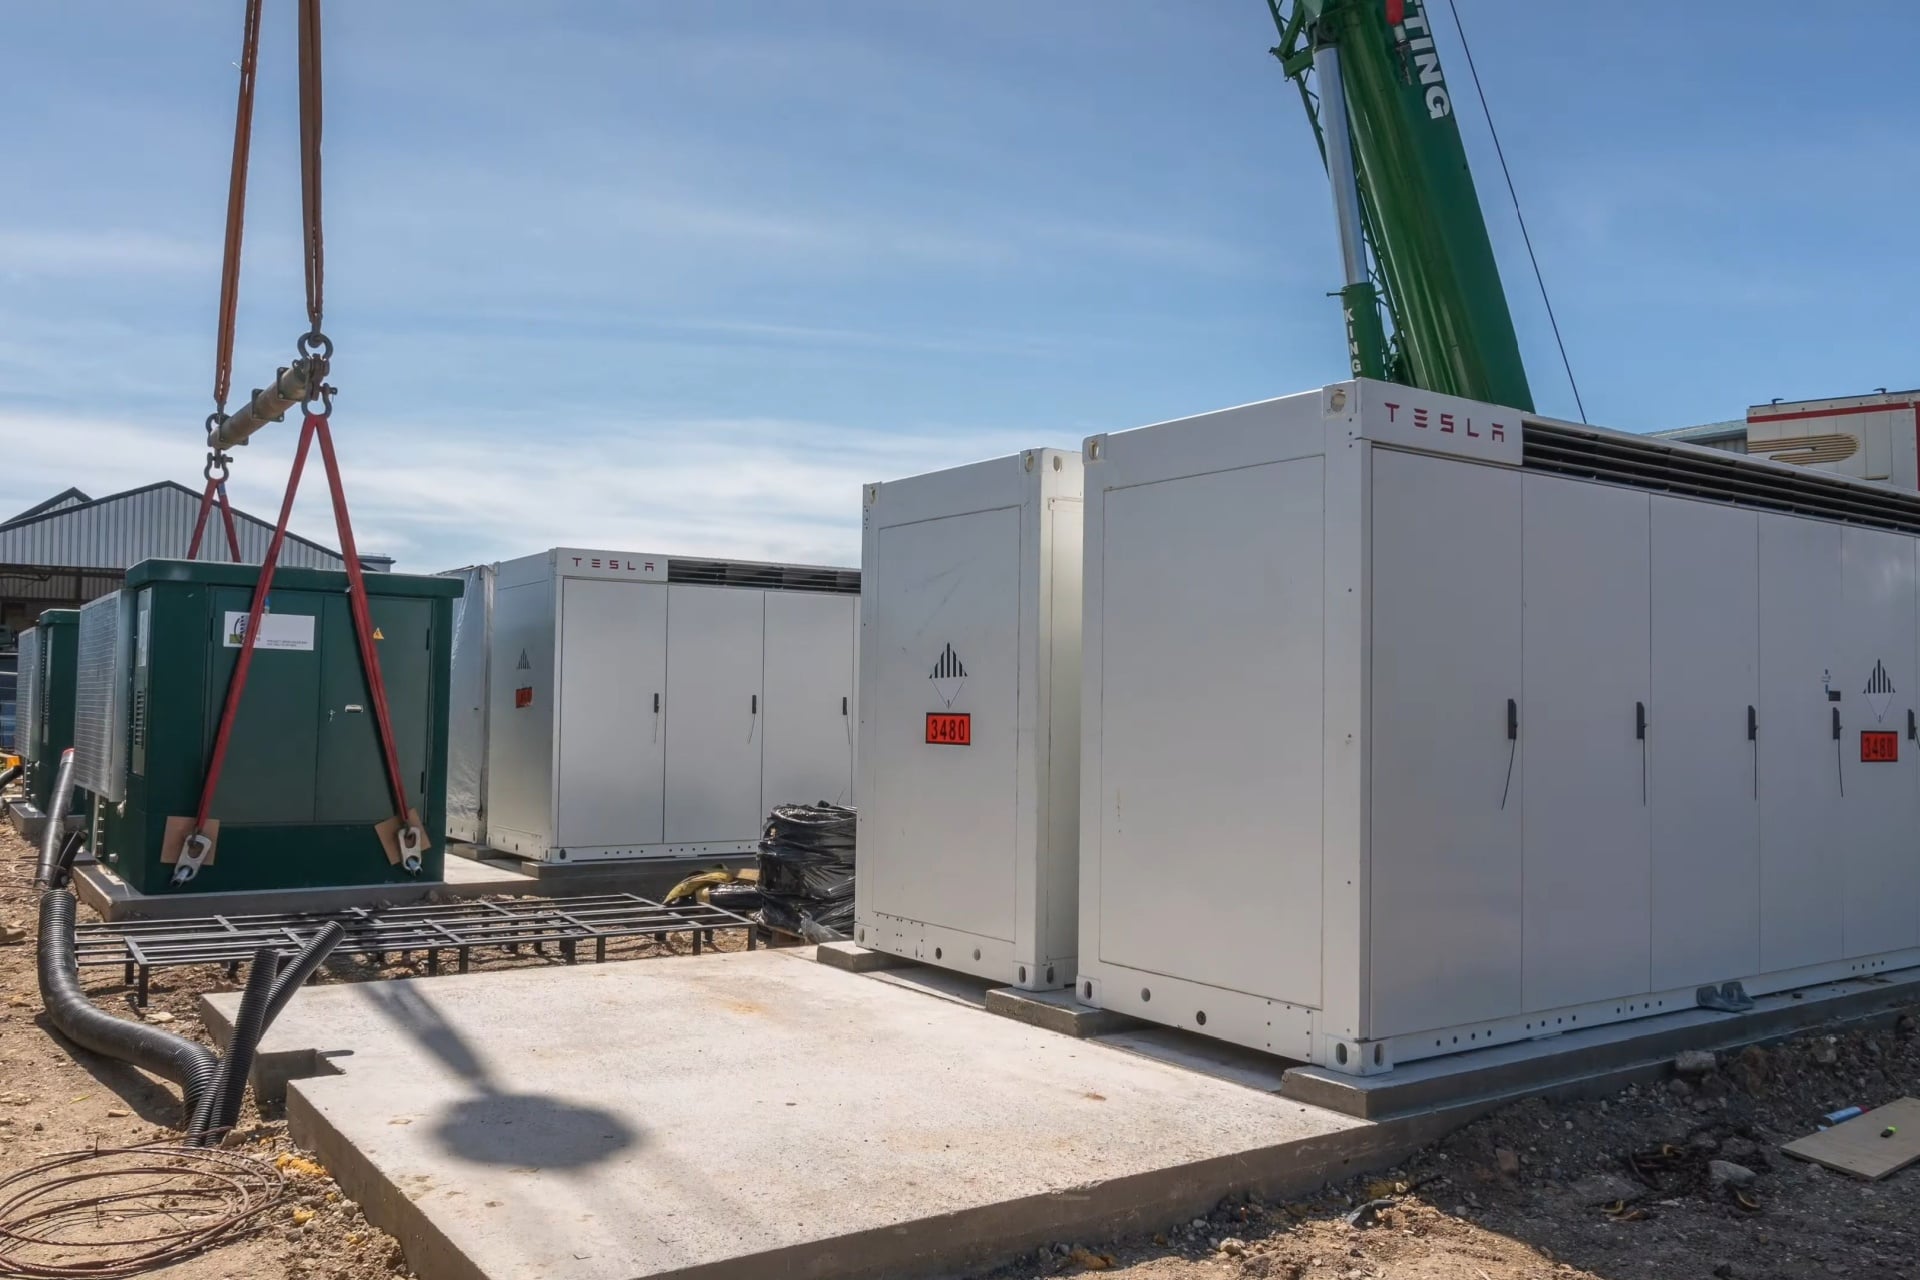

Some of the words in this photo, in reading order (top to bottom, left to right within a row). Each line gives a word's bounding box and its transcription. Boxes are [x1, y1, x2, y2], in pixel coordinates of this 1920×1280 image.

[1344, 307, 1361, 373] KING
[1384, 402, 1504, 443] TESLA
[572, 556, 654, 572] TESLA
[931, 719, 965, 741] 3480
